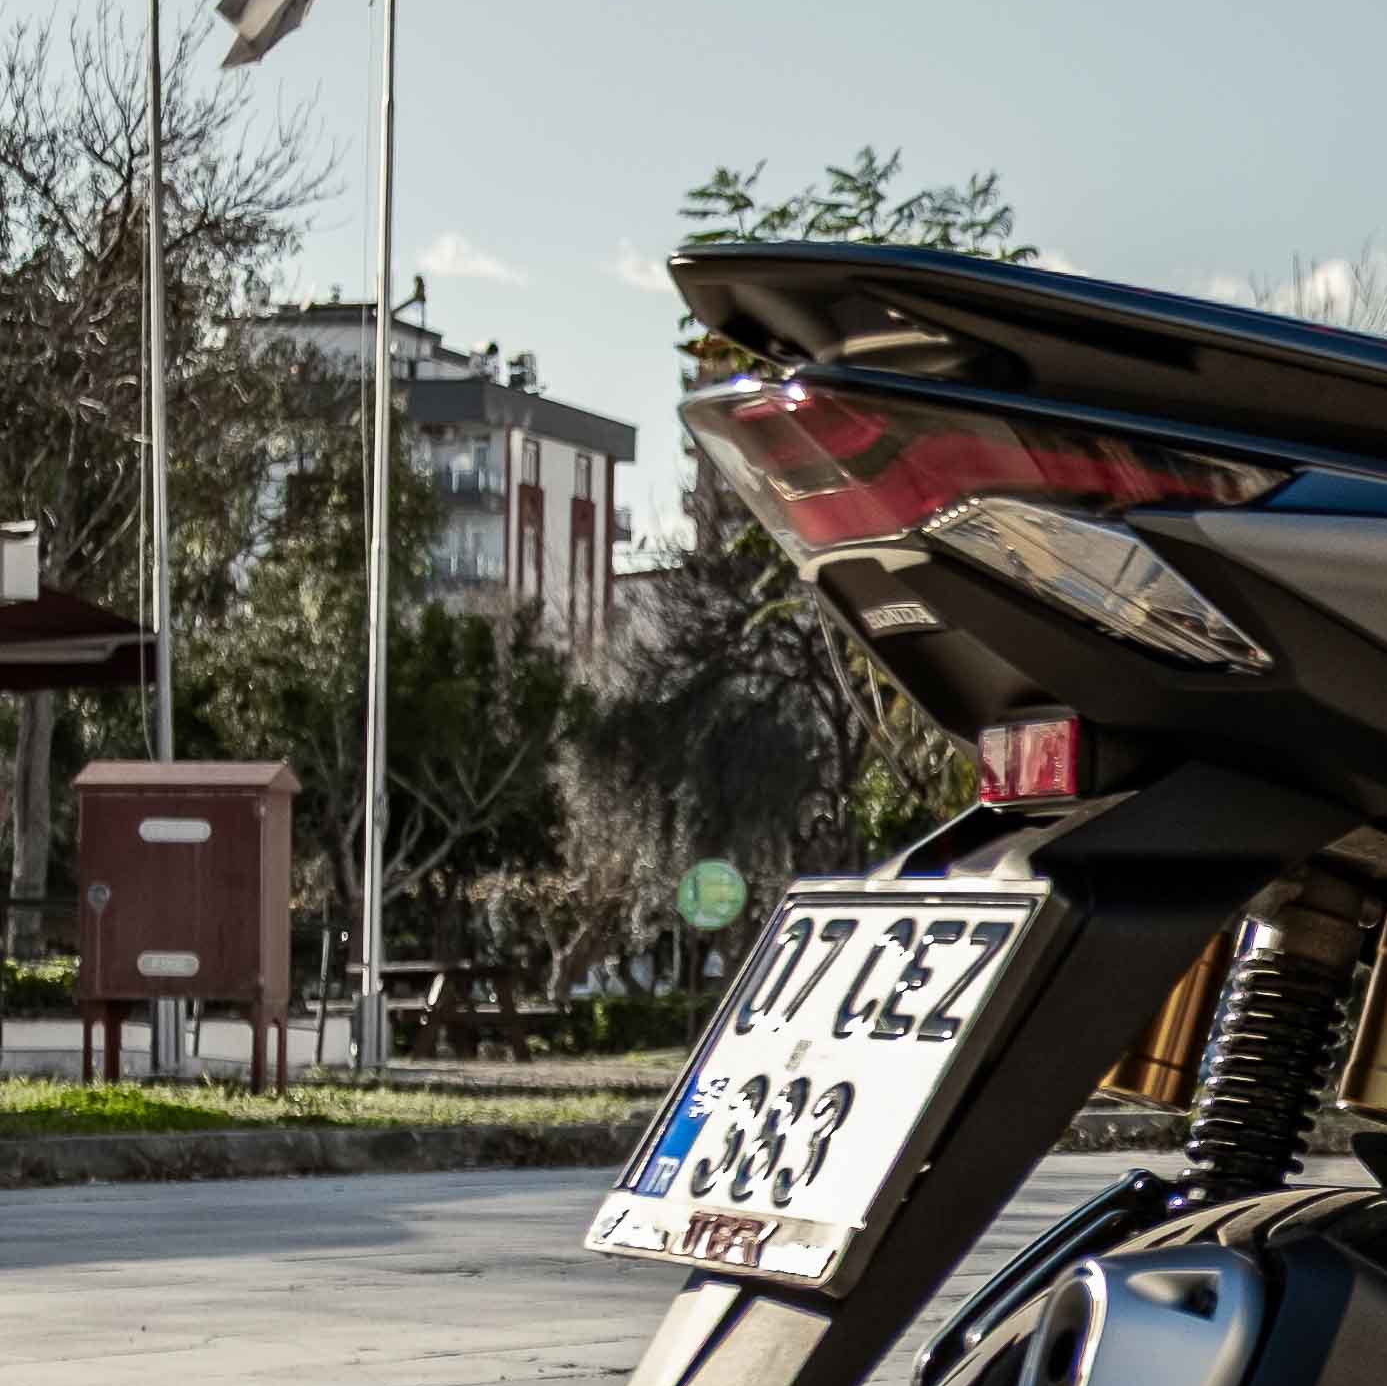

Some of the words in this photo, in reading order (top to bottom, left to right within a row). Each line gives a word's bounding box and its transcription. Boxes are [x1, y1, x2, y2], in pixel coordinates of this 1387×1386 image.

[862, 605, 938, 631] HONDA
[734, 916, 860, 1037] 07
[833, 916, 1016, 1042] CEZ
[643, 1157, 681, 1194] TR
